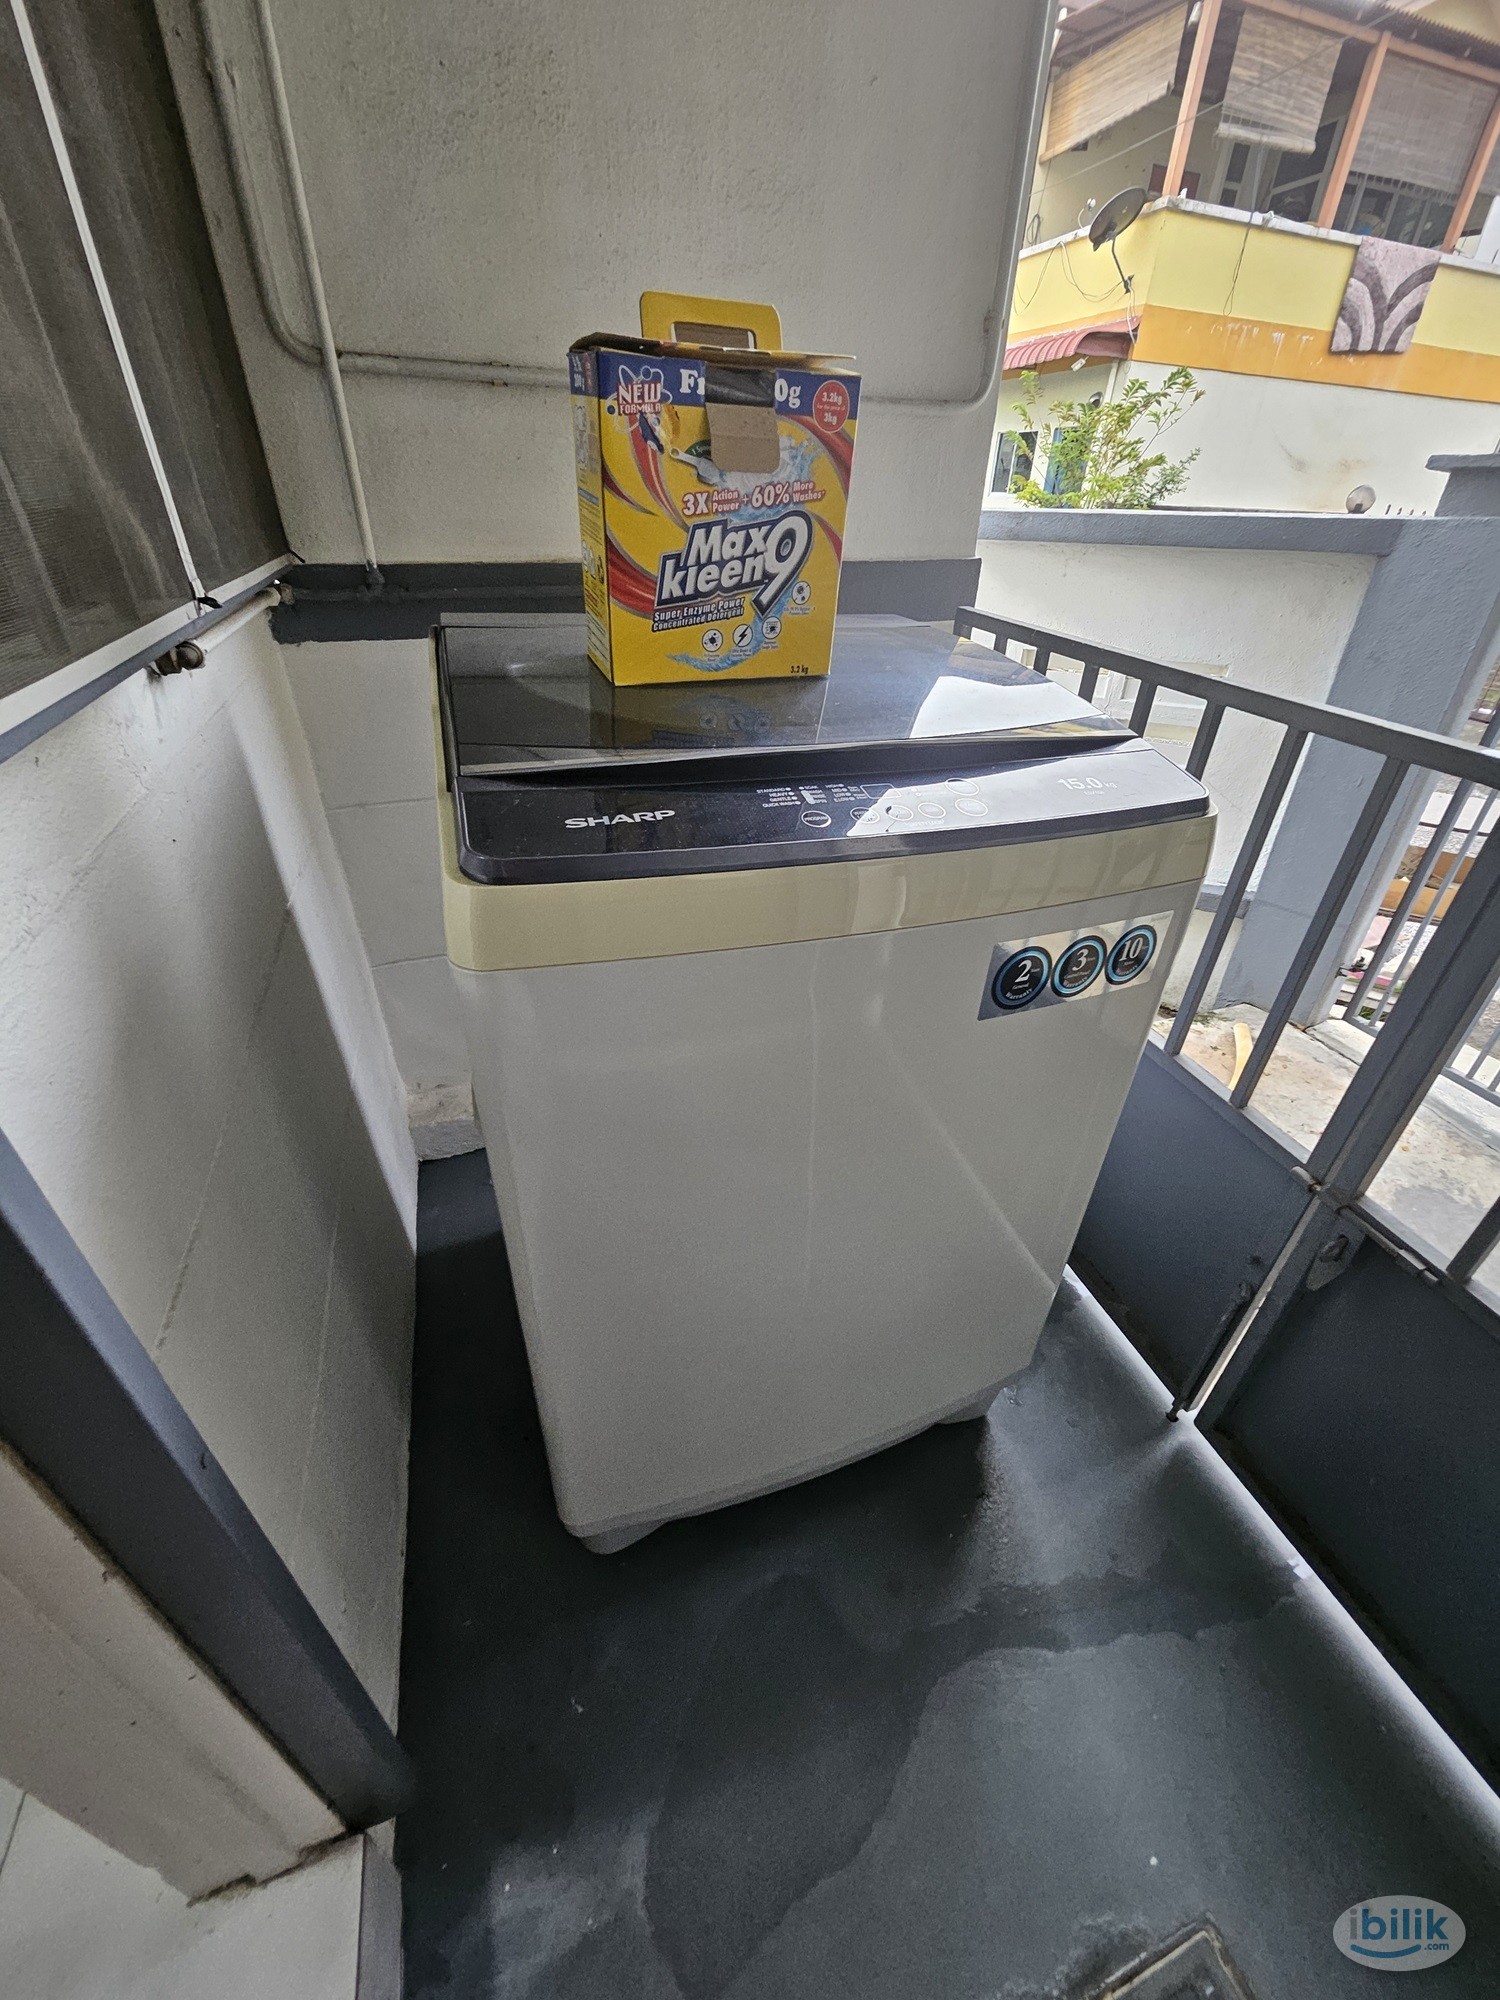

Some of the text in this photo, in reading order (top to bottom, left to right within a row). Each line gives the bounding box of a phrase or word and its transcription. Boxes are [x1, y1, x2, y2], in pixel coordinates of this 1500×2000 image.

[618, 382, 662, 405] NEW
[822, 391, 843, 406] 3.2kg
[619, 403, 662, 415] FORMULA
[823, 412, 838, 426] 3kg
[793, 480, 814, 491] More
[682, 491, 709, 516] 3X
[751, 482, 790, 508] 60%
[712, 489, 739, 502] Action
[712, 501, 740, 513] Power
[687, 525, 770, 567] Max
[654, 597, 745, 622] Super Enzyme Power
[653, 607, 744, 631] Concentrated Detergent
[801, 664, 809, 674] kg
[1057, 776, 1103, 790] 15.0
[564, 809, 676, 829] SHARP
[1119, 937, 1144, 962] 10
[1071, 948, 1089, 972] 3
[1014, 959, 1033, 983] 2
[1005, 987, 1033, 1000] Warranty
